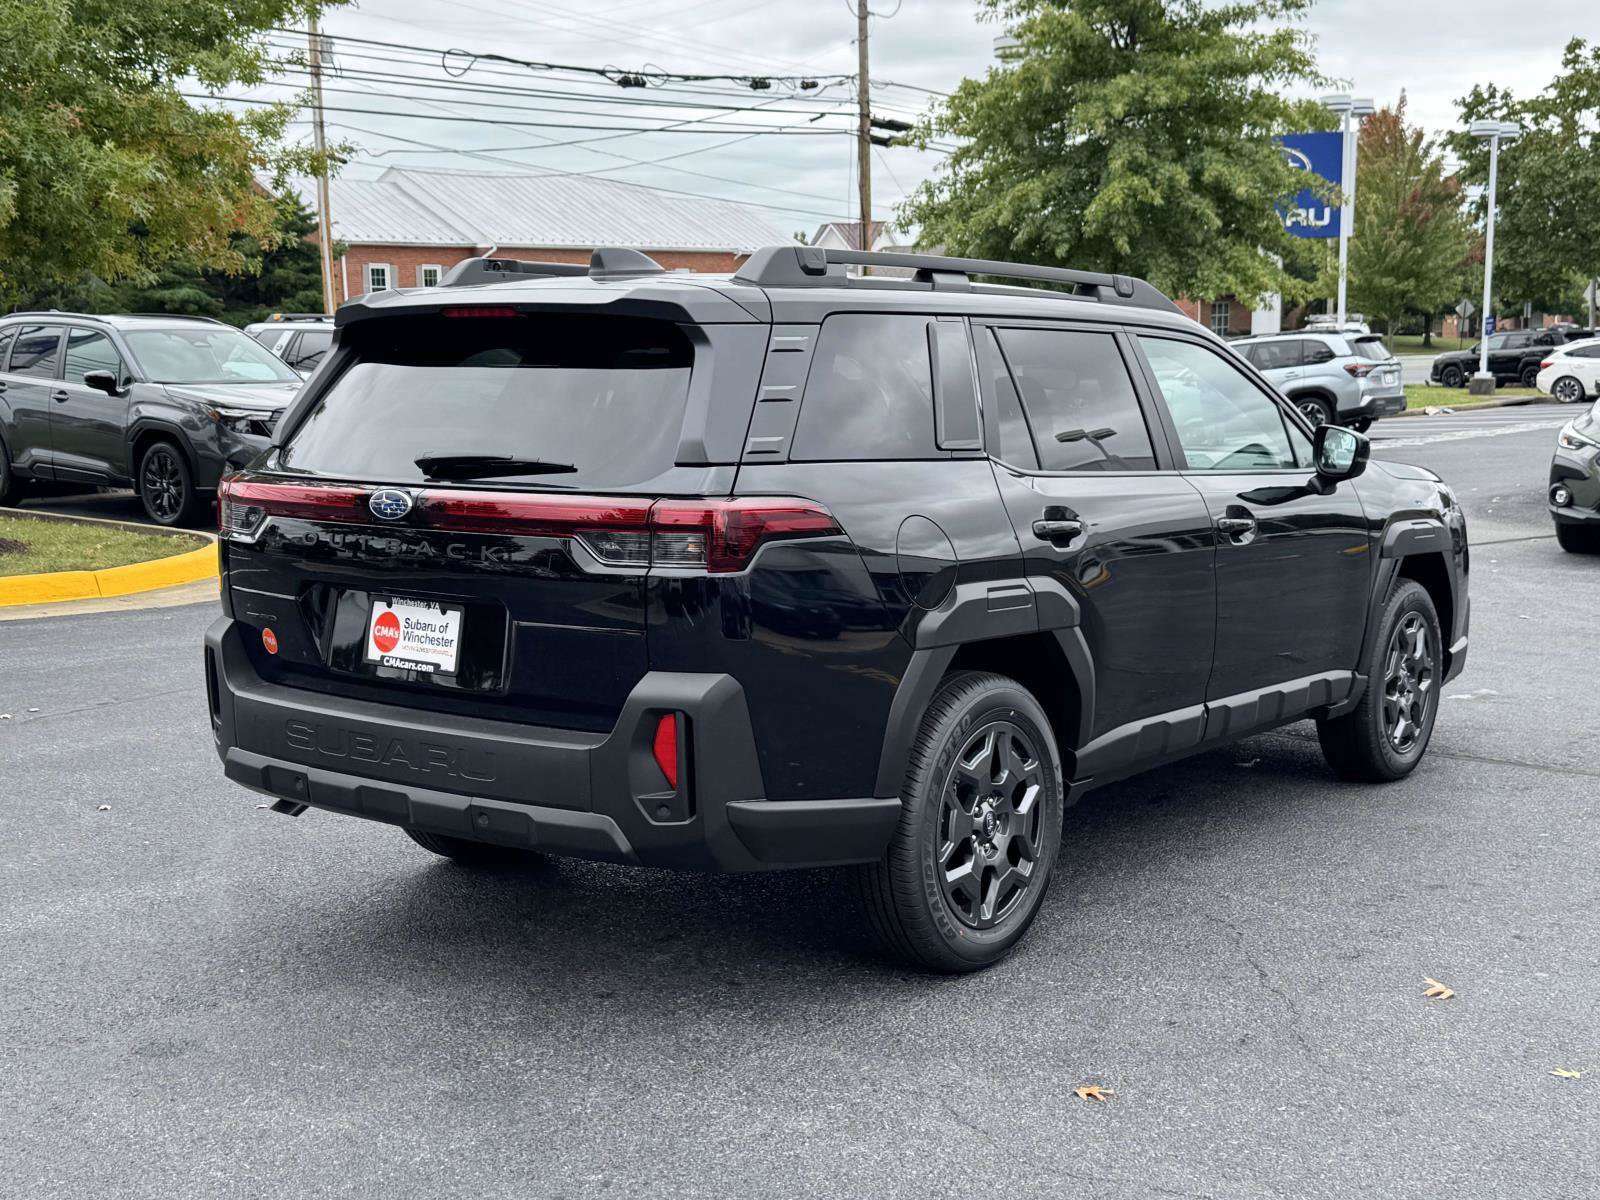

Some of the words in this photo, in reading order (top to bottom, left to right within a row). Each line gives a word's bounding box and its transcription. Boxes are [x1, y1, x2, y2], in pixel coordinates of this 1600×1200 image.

[301, 531, 500, 562] OUTBACK
[430, 601, 440, 611] VA
[403, 617, 436, 633] Subaru
[438, 622, 450, 635] of
[402, 630, 455, 648] Winchester
[383, 657, 434, 673] CMAcars.com
[285, 719, 497, 782] SUBARU
